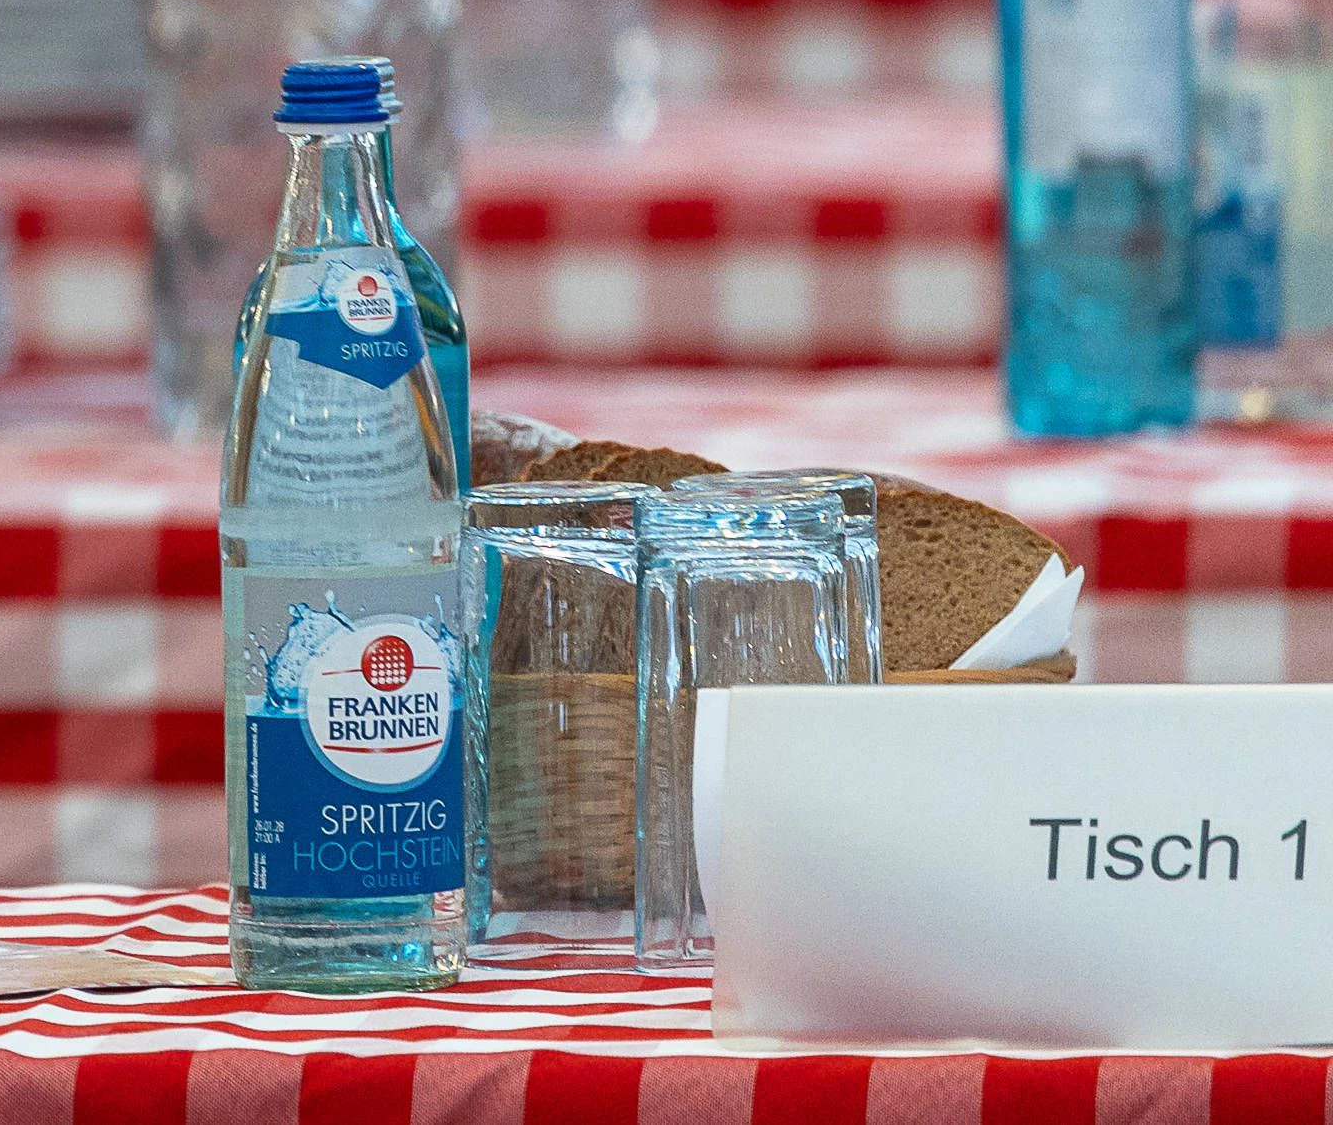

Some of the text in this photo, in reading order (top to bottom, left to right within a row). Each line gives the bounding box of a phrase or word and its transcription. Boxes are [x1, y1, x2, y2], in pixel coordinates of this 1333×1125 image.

[340, 340, 409, 361] SPRITZIG
[328, 691, 439, 718] FRANKEN
[329, 715, 439, 741] BRUNNEN
[320, 798, 448, 836] SPRITZIG
[293, 835, 461, 873] HOCHSTEIN
[1029, 817, 1308, 883] Tisch 1
[362, 871, 422, 888] QUELLE
